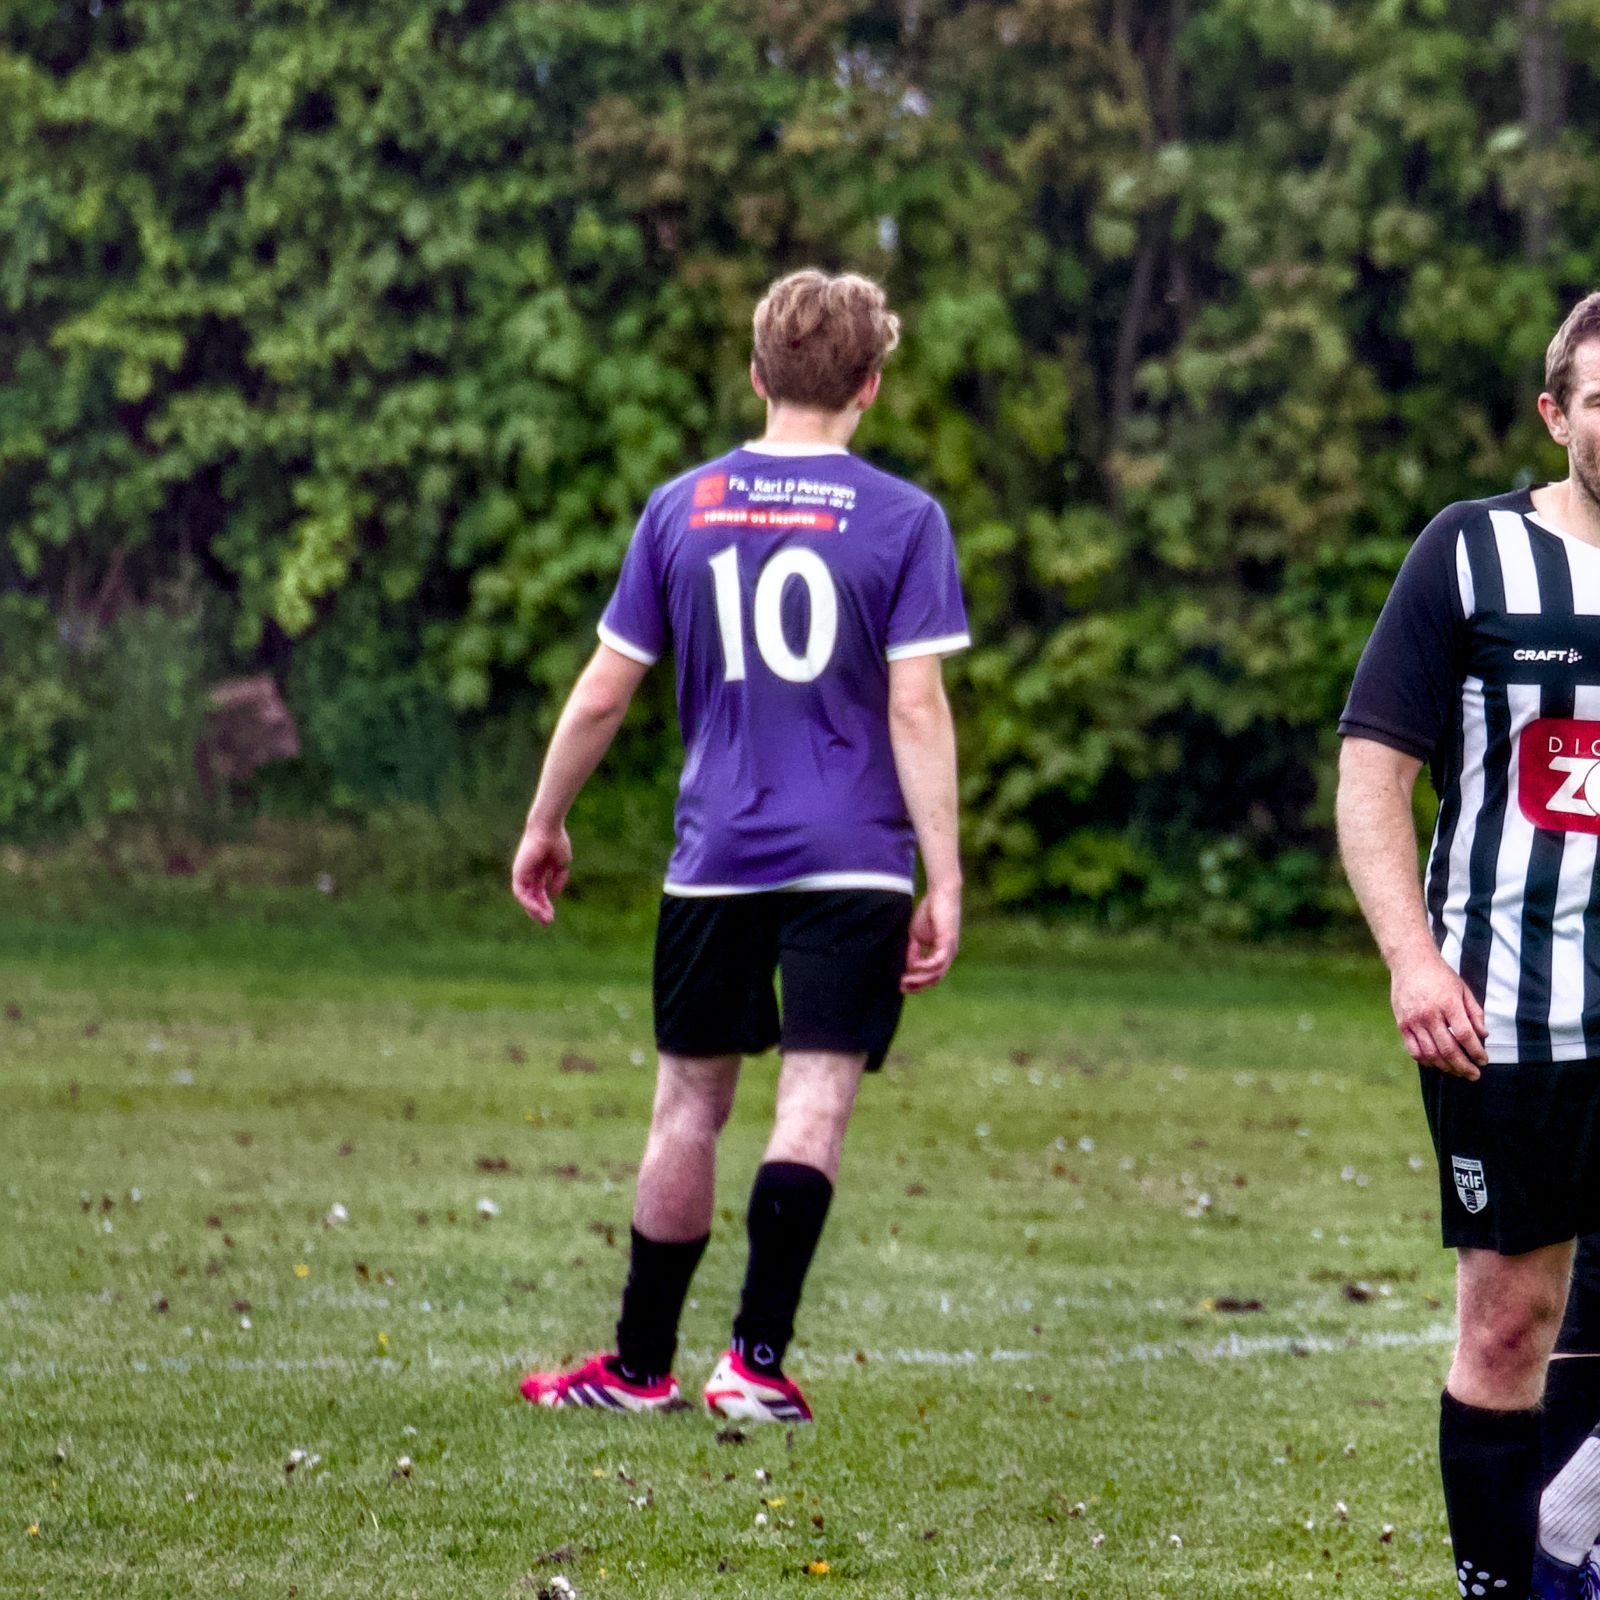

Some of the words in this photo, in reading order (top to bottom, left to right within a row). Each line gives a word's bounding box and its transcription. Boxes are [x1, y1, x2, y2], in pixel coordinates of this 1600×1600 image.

[729, 475, 749, 491] Fa.
[754, 476, 782, 492] Karl
[785, 477, 796, 493] D
[797, 478, 856, 500] Petersen
[708, 543, 838, 683] 10
[1513, 649, 1567, 661] CRAFT
